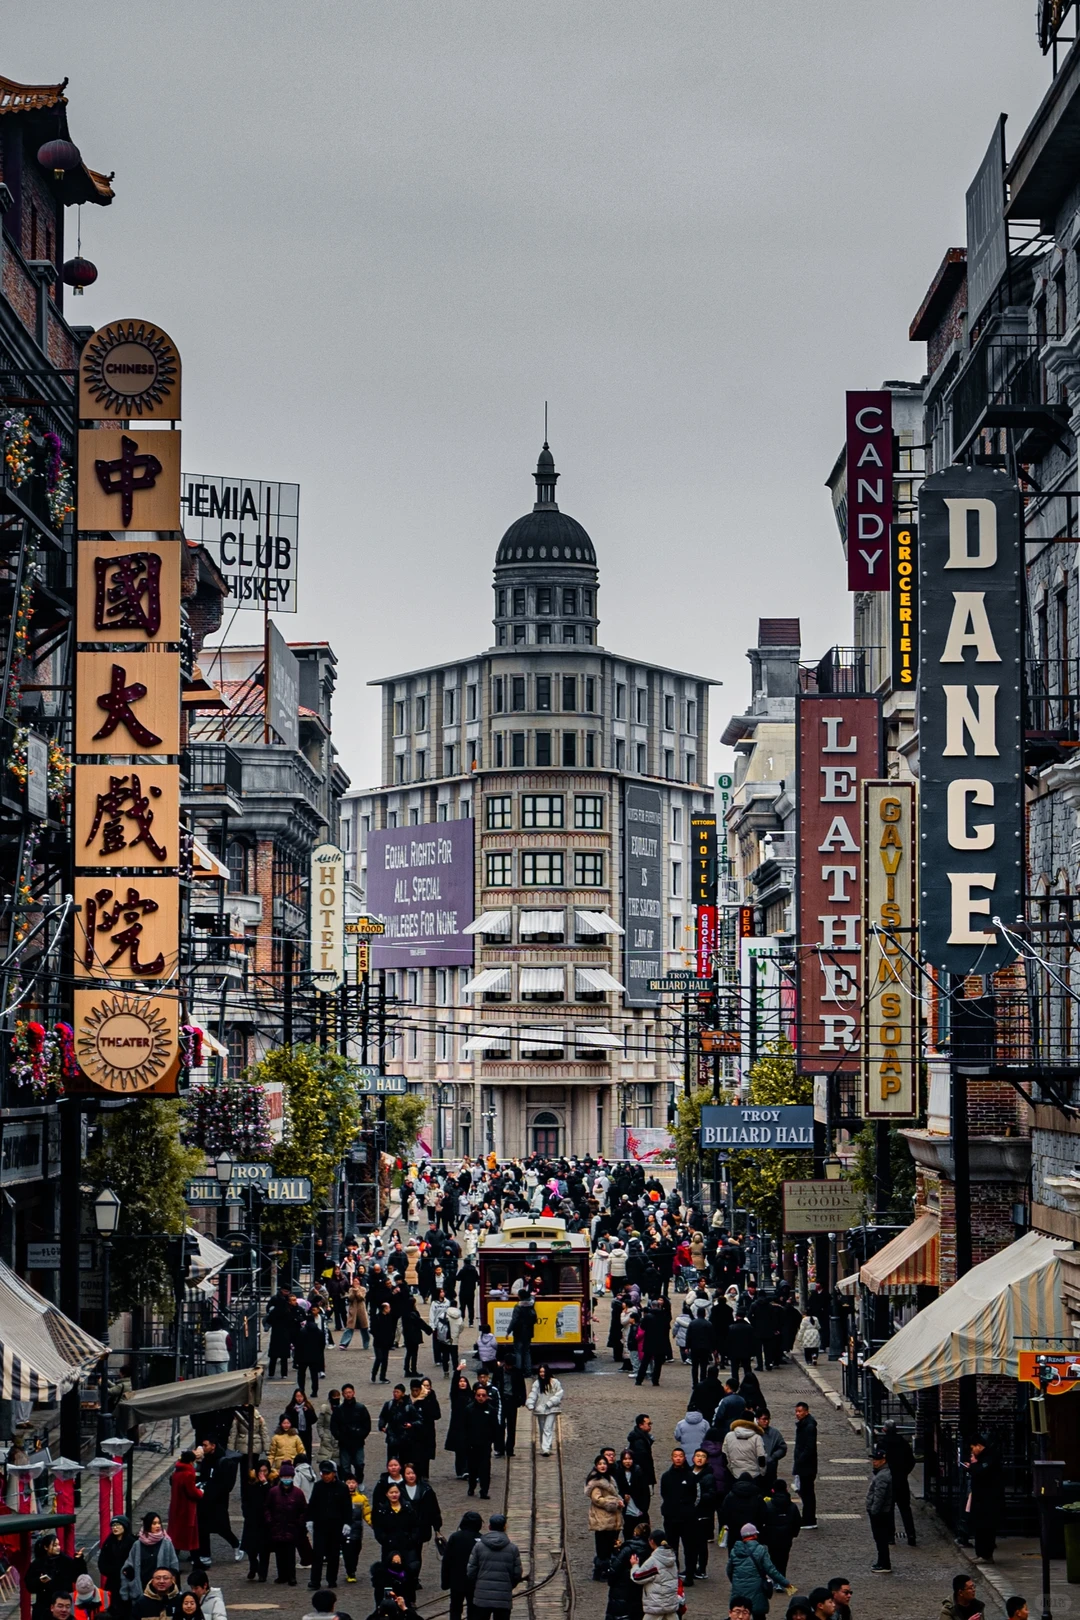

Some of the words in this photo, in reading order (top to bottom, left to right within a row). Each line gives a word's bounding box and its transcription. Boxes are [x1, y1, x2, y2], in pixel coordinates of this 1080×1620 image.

[106, 363, 155, 375] CHINESE
[855, 406, 884, 575] CANDY
[221, 532, 291, 569] CLUB
[224, 574, 290, 602] HISKEY
[897, 531, 912, 683] GROCERIEIS
[939, 498, 1003, 945] DANCE
[631, 836, 657, 857] EQUALITY
[699, 831, 708, 898] HOTEL
[641, 867, 648, 887] IS
[818, 717, 861, 1052] LEATHER
[628, 897, 639, 916] THE
[319, 866, 336, 970] HOTEL
[630, 960, 659, 978] HUMANITY
[650, 980, 687, 990] BILLIARD
[689, 980, 710, 990] HALL
[99, 1037, 150, 1047] THEATER
[880, 993, 902, 1100] SOAP
[376, 1078, 404, 1090] HALL
[741, 1110, 780, 1121] TROY
[705, 1127, 772, 1143] BILIARD
[231, 1166, 270, 1178] TROY
[267, 1181, 307, 1199] HALL
[797, 1196, 850, 1207] GOODS
[805, 1214, 843, 1223] STORE
